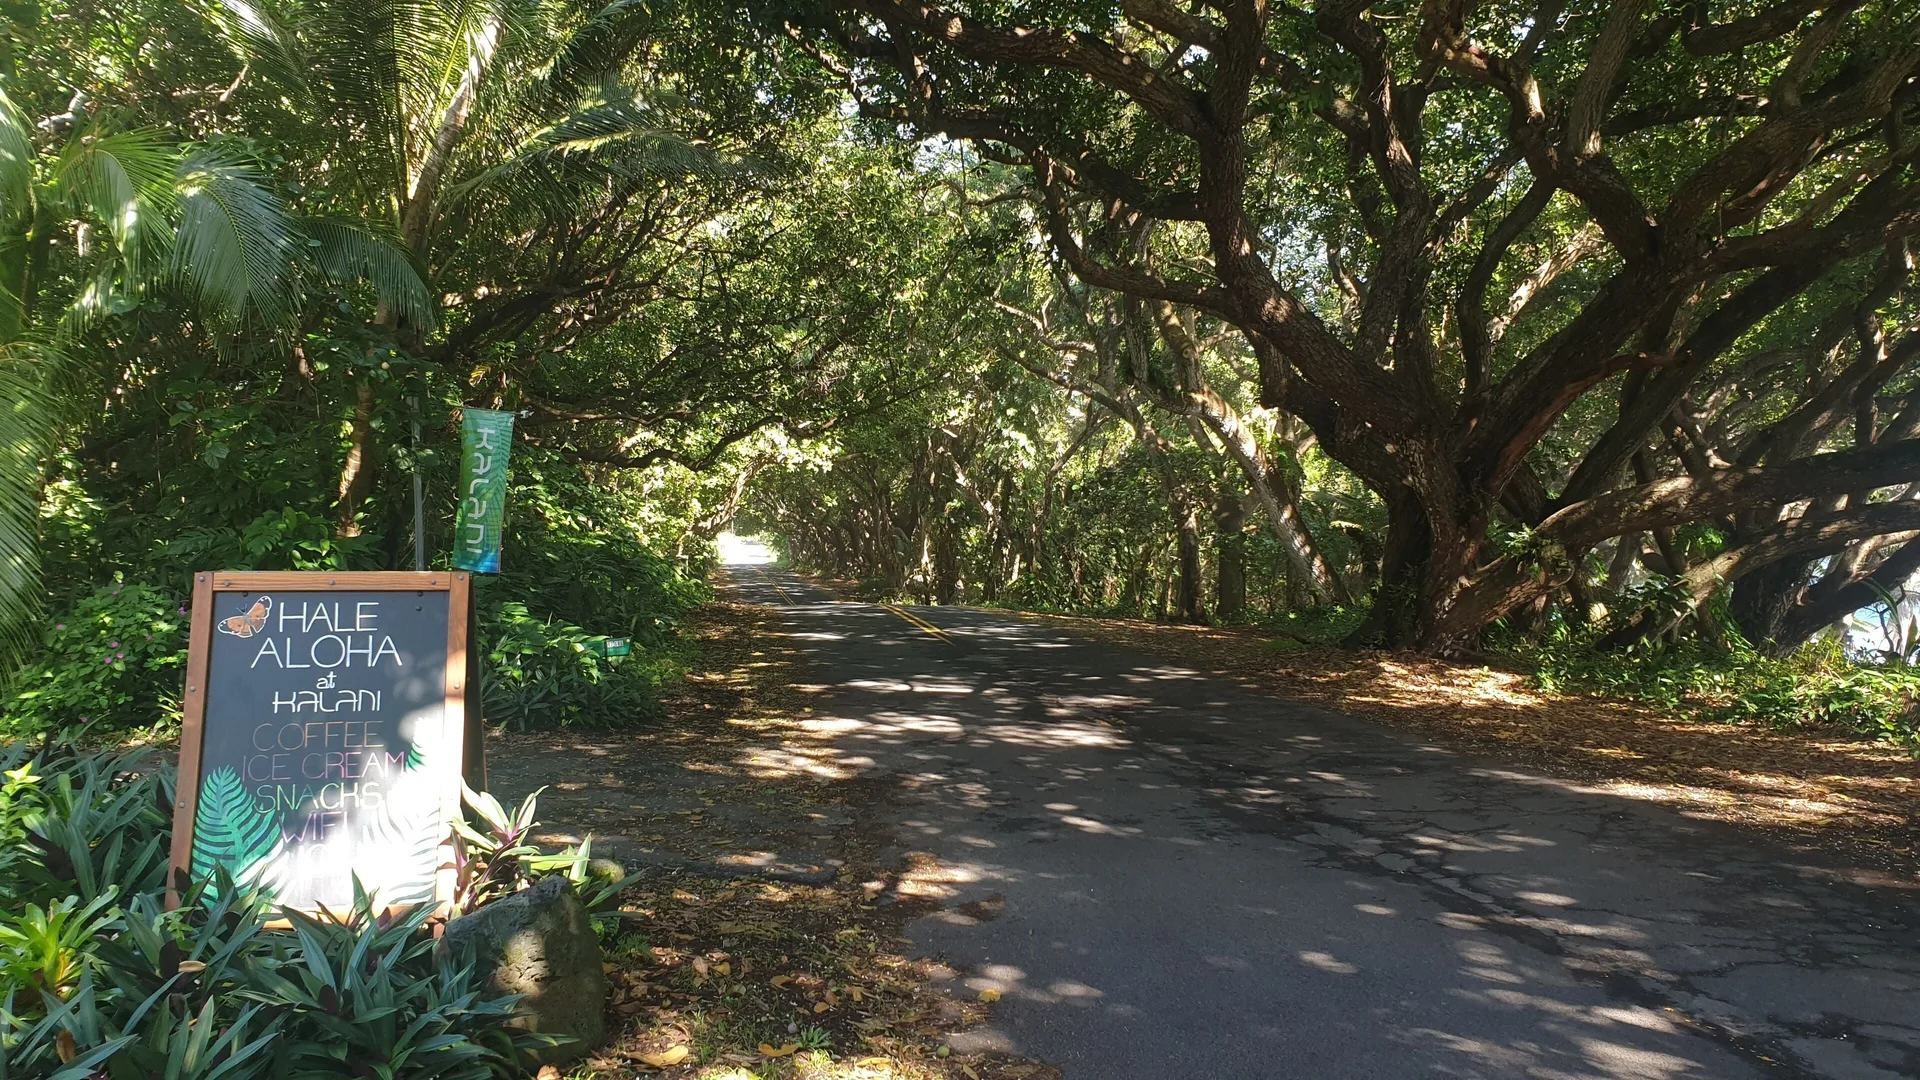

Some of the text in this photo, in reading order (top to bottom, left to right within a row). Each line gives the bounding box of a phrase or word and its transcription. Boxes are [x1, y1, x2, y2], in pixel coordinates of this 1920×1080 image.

[279, 601, 379, 633] HALE
[250, 634, 403, 669] ALOHA
[316, 670, 337, 689] at
[252, 720, 384, 751] COFFEE
[241, 751, 405, 782] ICE CREAM
[253, 782, 382, 814] SNACKS
